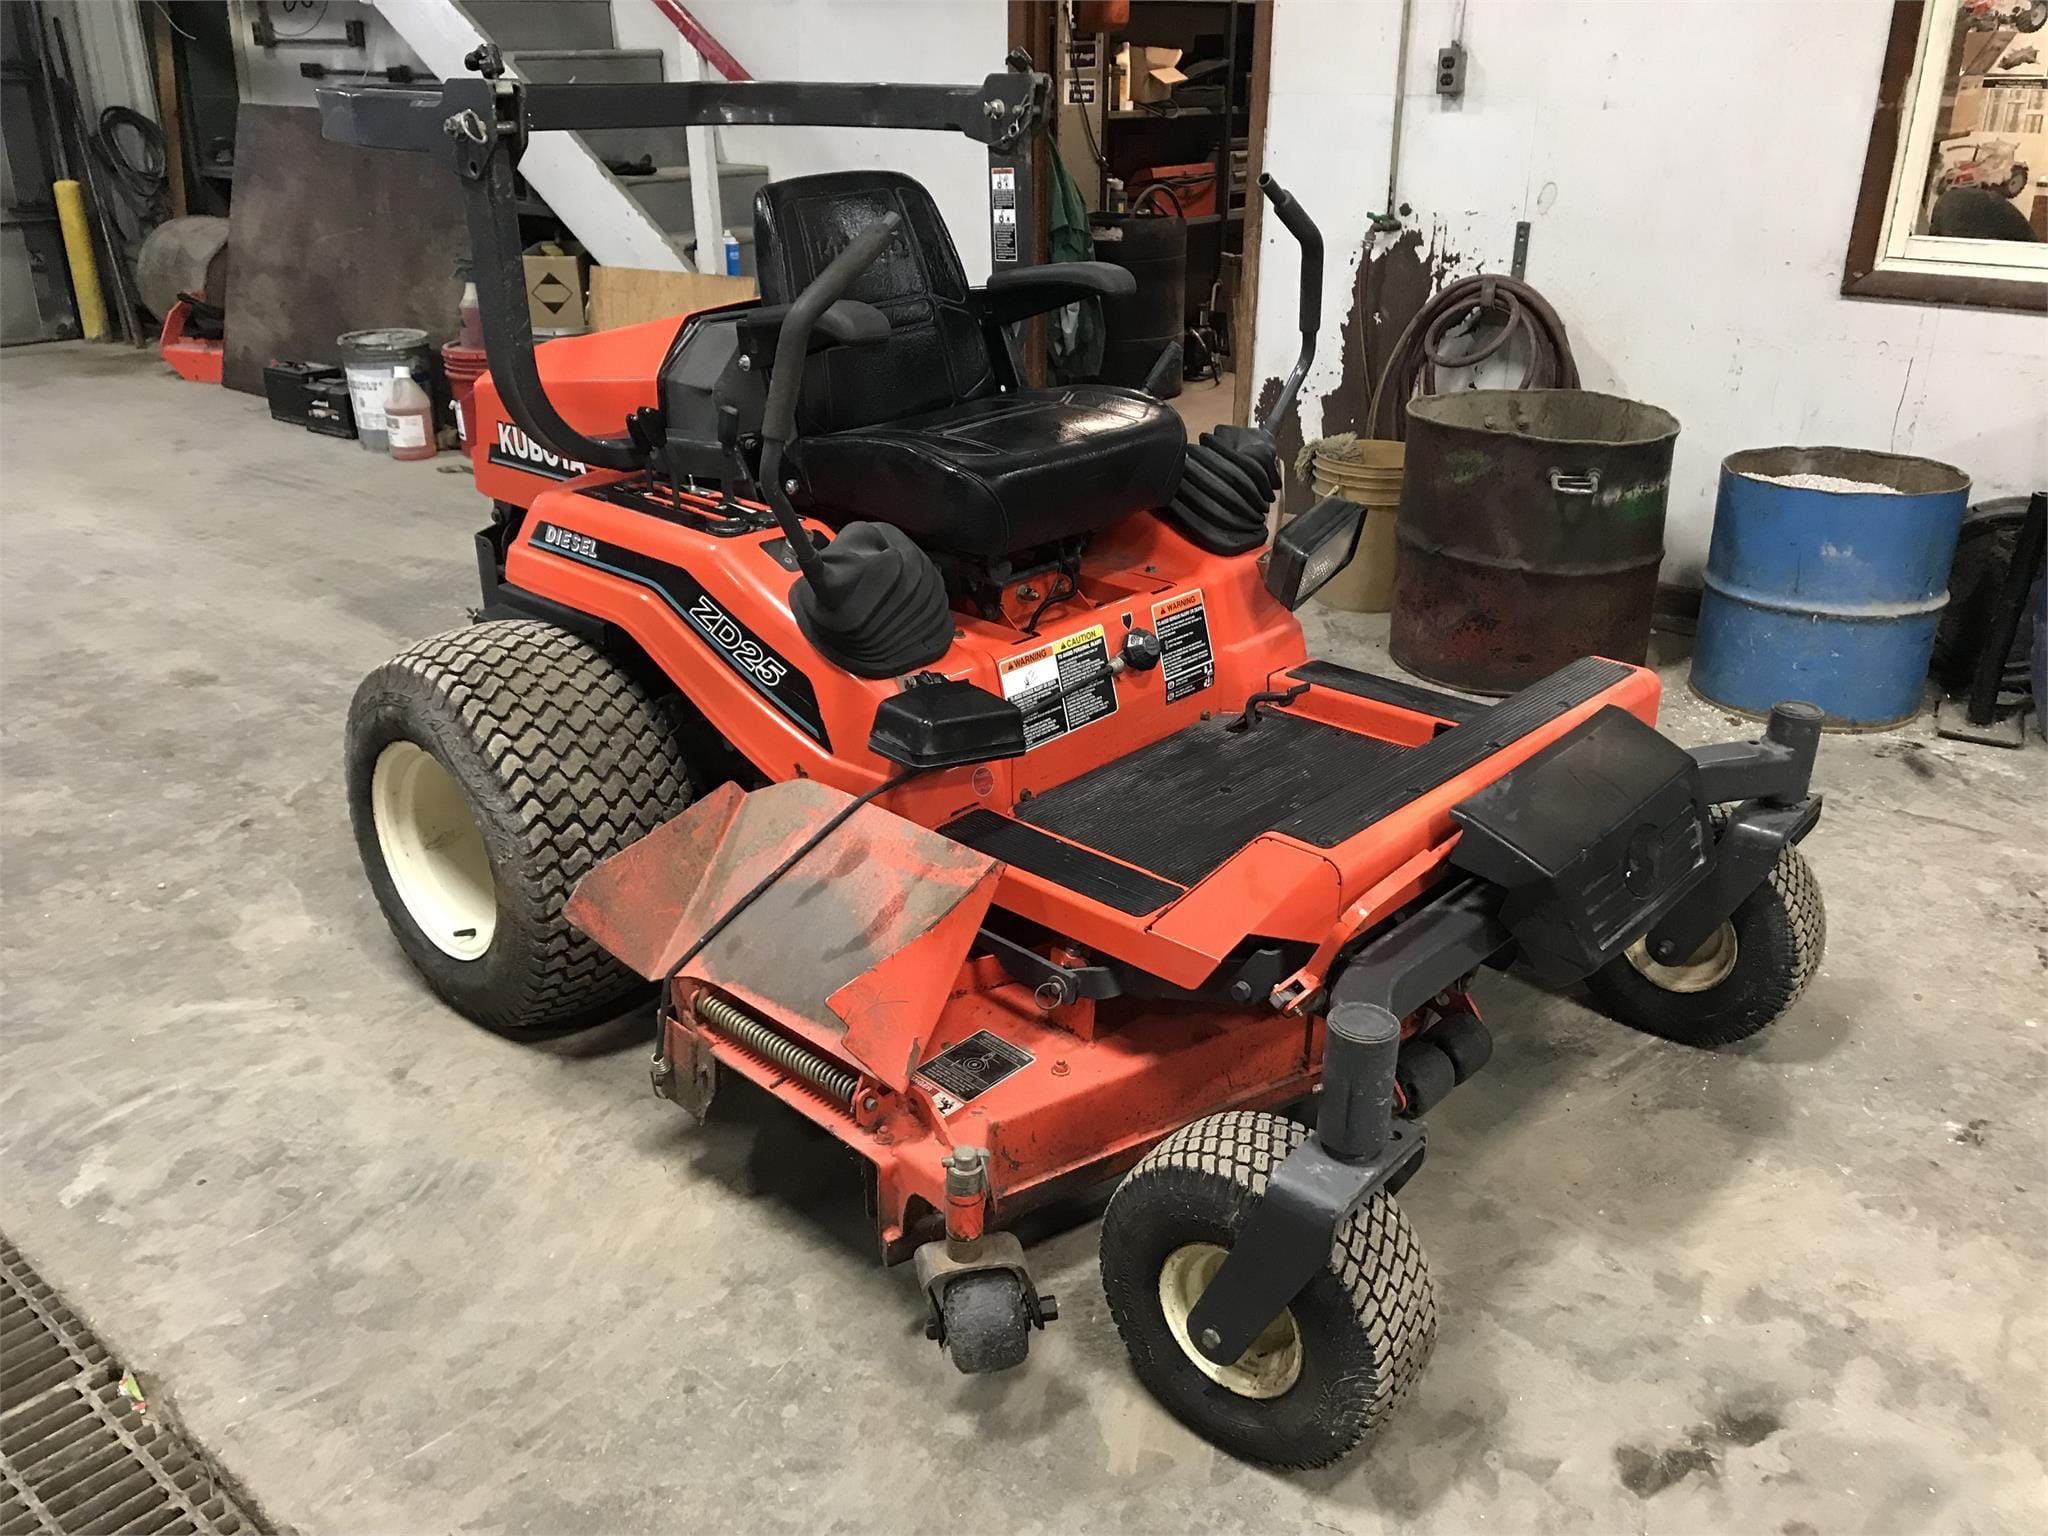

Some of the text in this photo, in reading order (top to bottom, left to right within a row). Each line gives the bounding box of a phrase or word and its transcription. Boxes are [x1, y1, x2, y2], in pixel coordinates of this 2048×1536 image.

[545, 524, 598, 559] DIESEL
[1166, 595, 1196, 612] WARNING
[689, 595, 787, 686] ZD25
[1066, 630, 1097, 648] CAUTION
[1014, 649, 1047, 667] WARNING
